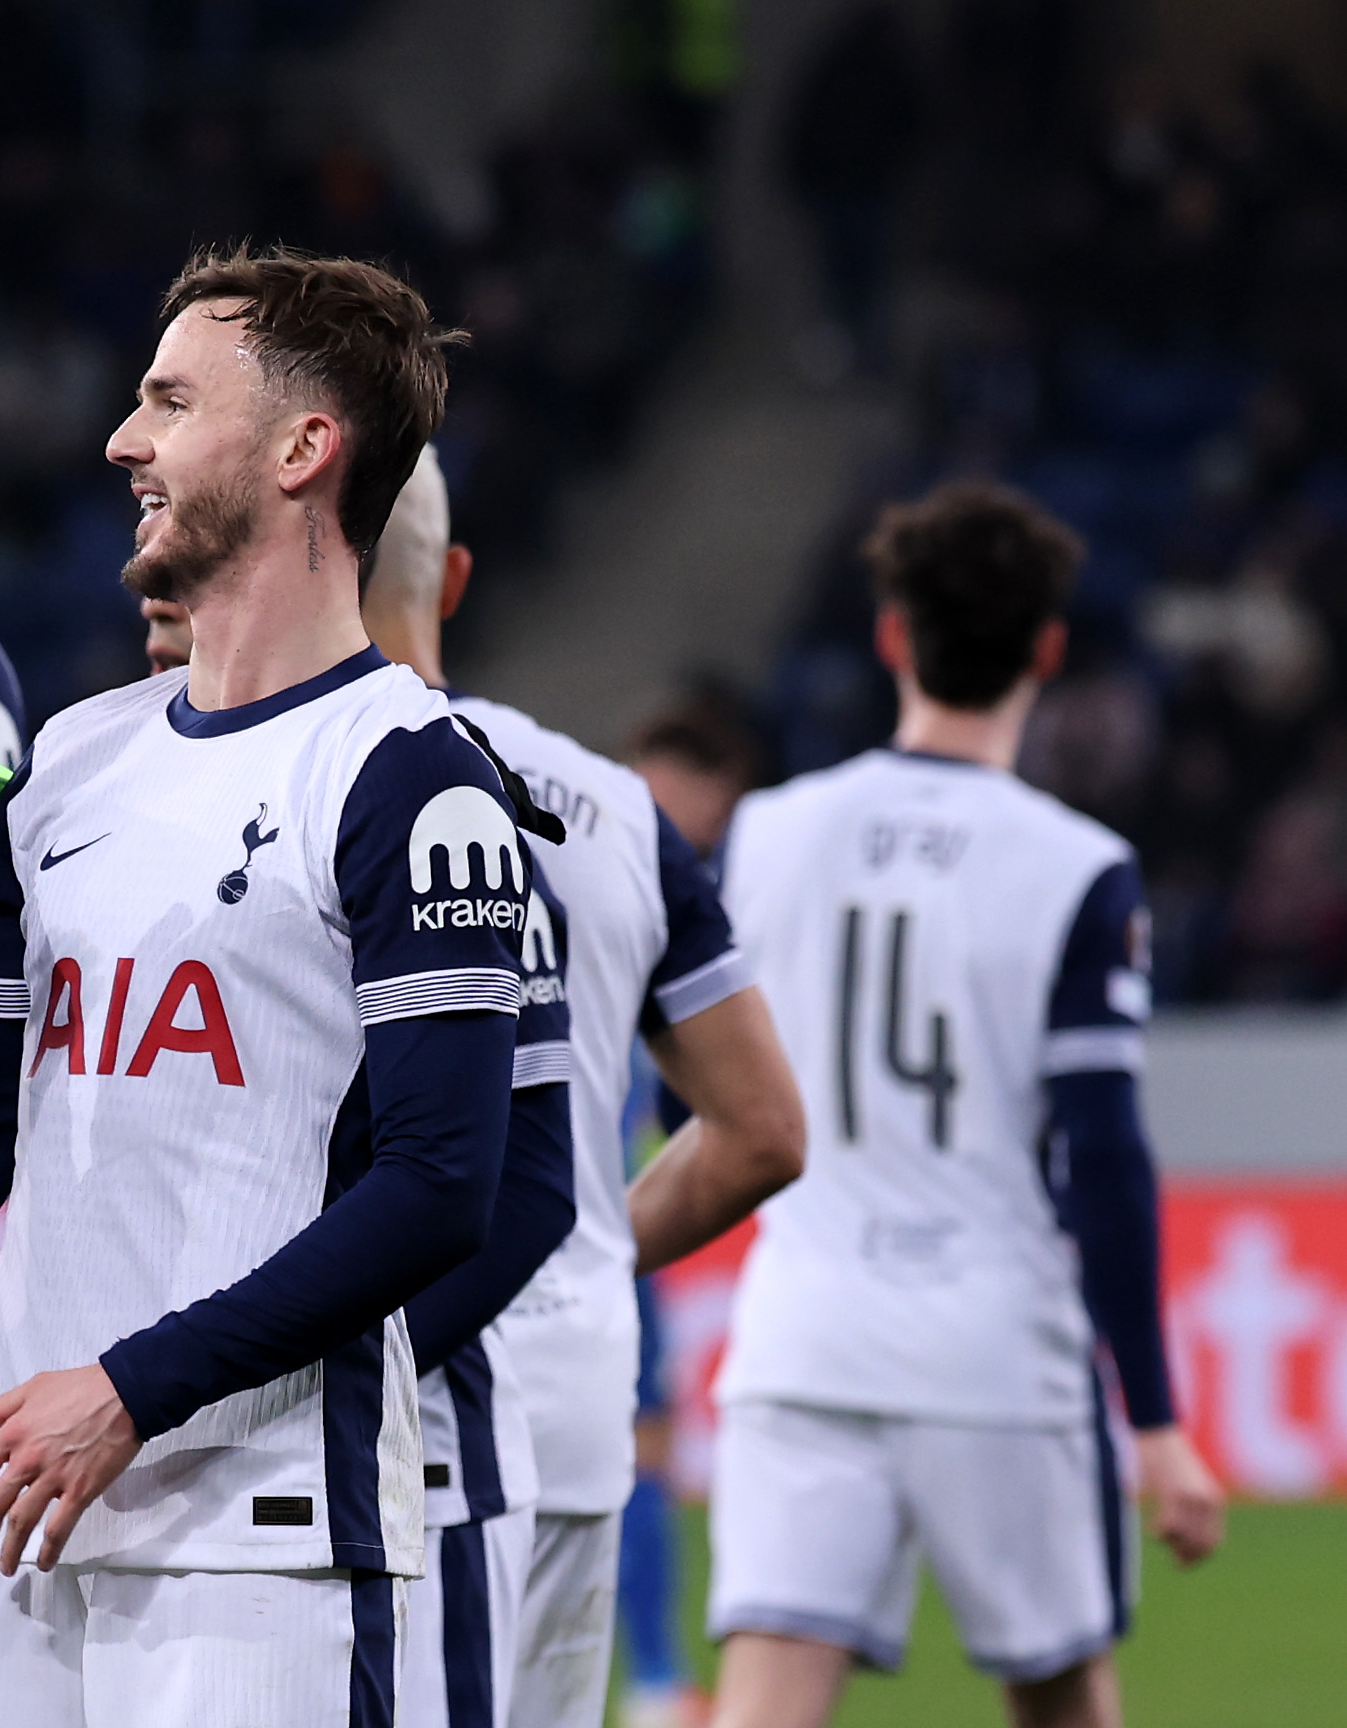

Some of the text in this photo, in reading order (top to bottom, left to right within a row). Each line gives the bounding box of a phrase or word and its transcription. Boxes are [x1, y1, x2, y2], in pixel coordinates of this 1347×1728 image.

[411, 898, 526, 932] kraken
[27, 957, 246, 1087] AIA
[519, 975, 565, 1007] ken
[837, 903, 960, 1152] 14
